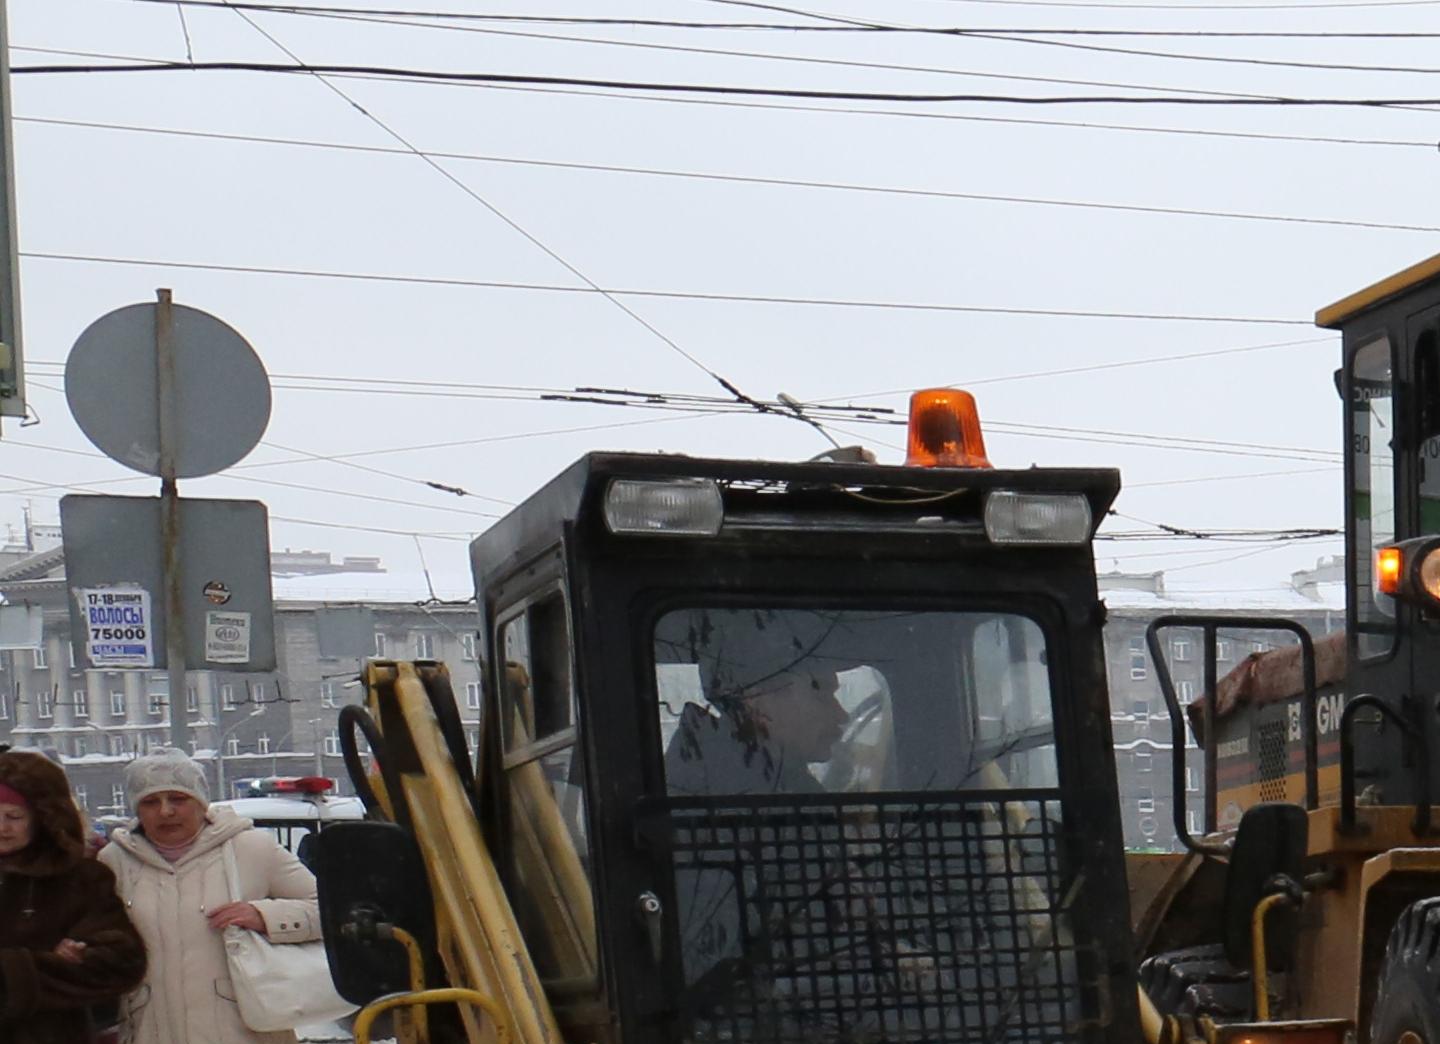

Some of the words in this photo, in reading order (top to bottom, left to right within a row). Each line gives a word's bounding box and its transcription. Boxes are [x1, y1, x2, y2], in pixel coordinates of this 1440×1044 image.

[88, 594, 114, 605] 17-18
[90, 606, 144, 625] ВОЛОСЫ
[91, 628, 146, 640] 75000
[1316, 693, 1345, 735] GM
